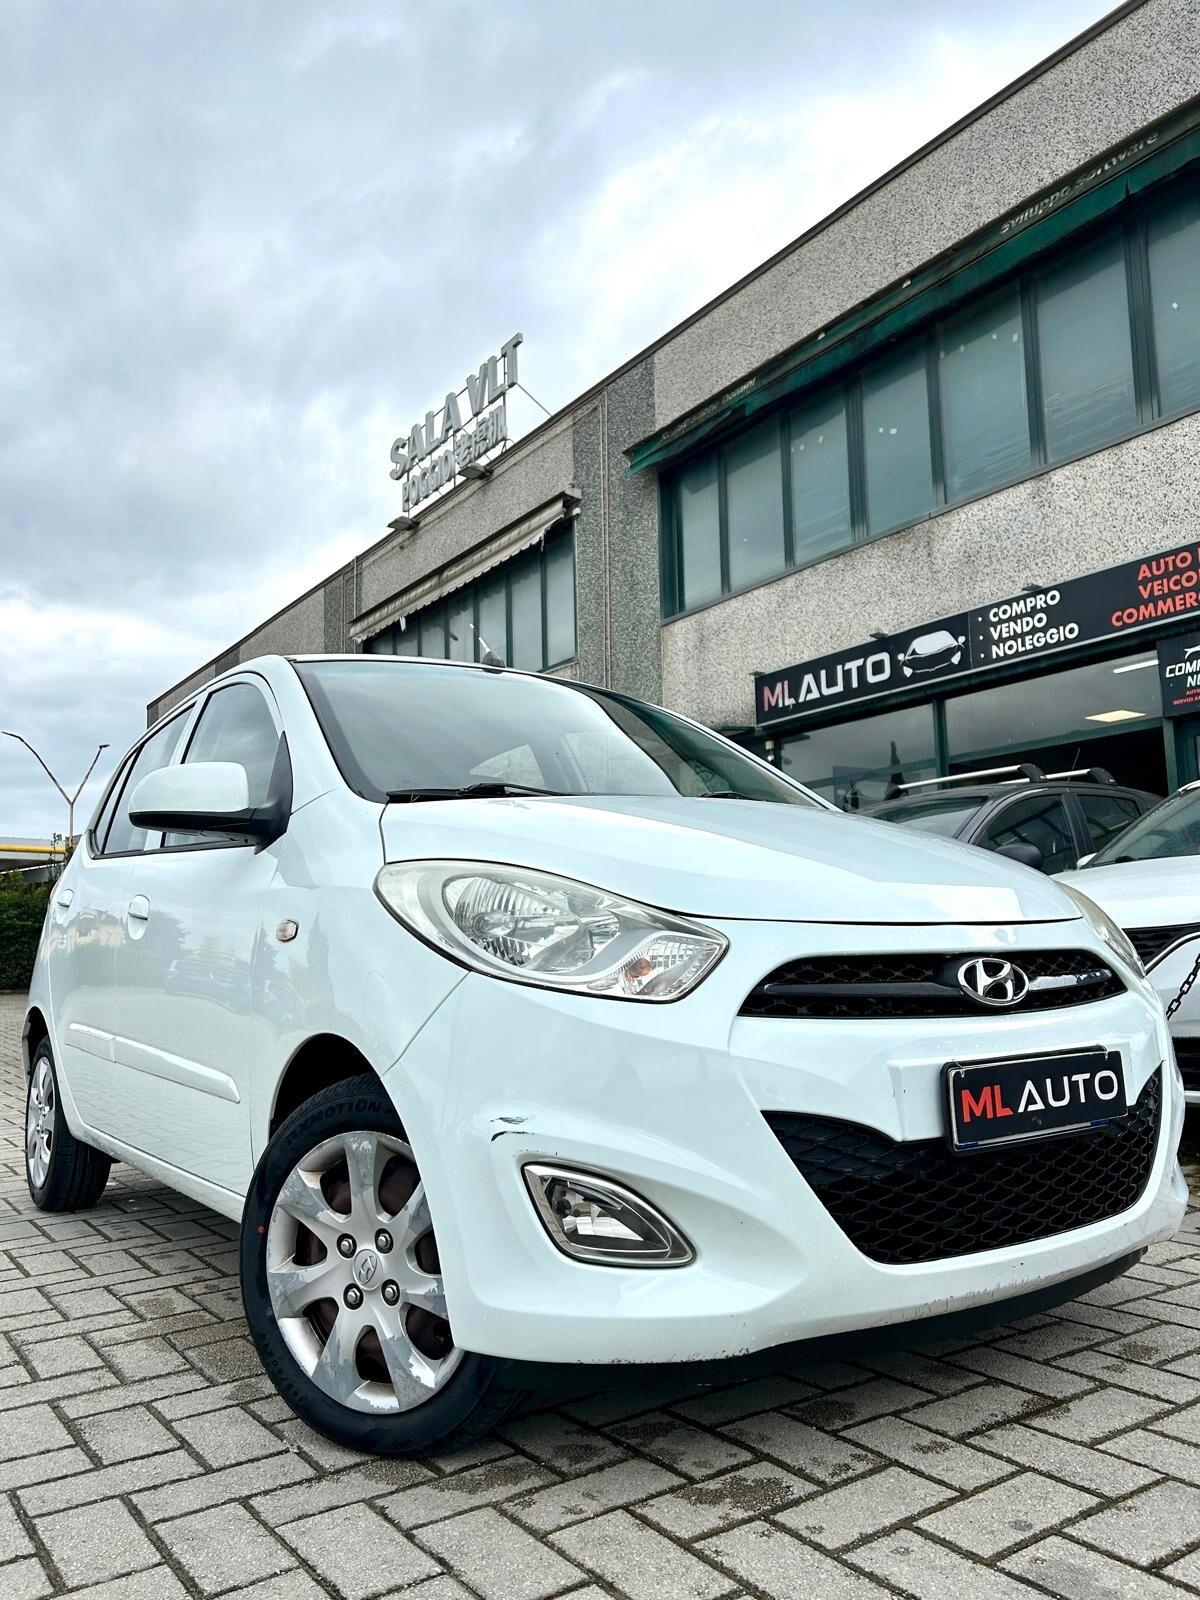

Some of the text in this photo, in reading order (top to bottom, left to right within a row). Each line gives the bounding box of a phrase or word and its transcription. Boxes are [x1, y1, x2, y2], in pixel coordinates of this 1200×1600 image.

[1000, 185, 1071, 234] Sviluppo
[390, 332, 524, 481] SALA VLT
[402, 450, 456, 512] POGGIO
[1137, 551, 1193, 581] AUTO
[1138, 570, 1200, 600] VEICO
[989, 589, 1061, 623] COMPRO
[1111, 591, 1200, 627] COMMER
[989, 612, 1048, 641] VENDO
[991, 622, 1080, 659] NOLEGGIO
[798, 651, 892, 704] AUTO
[961, 1069, 1119, 1123] ML AUTO
